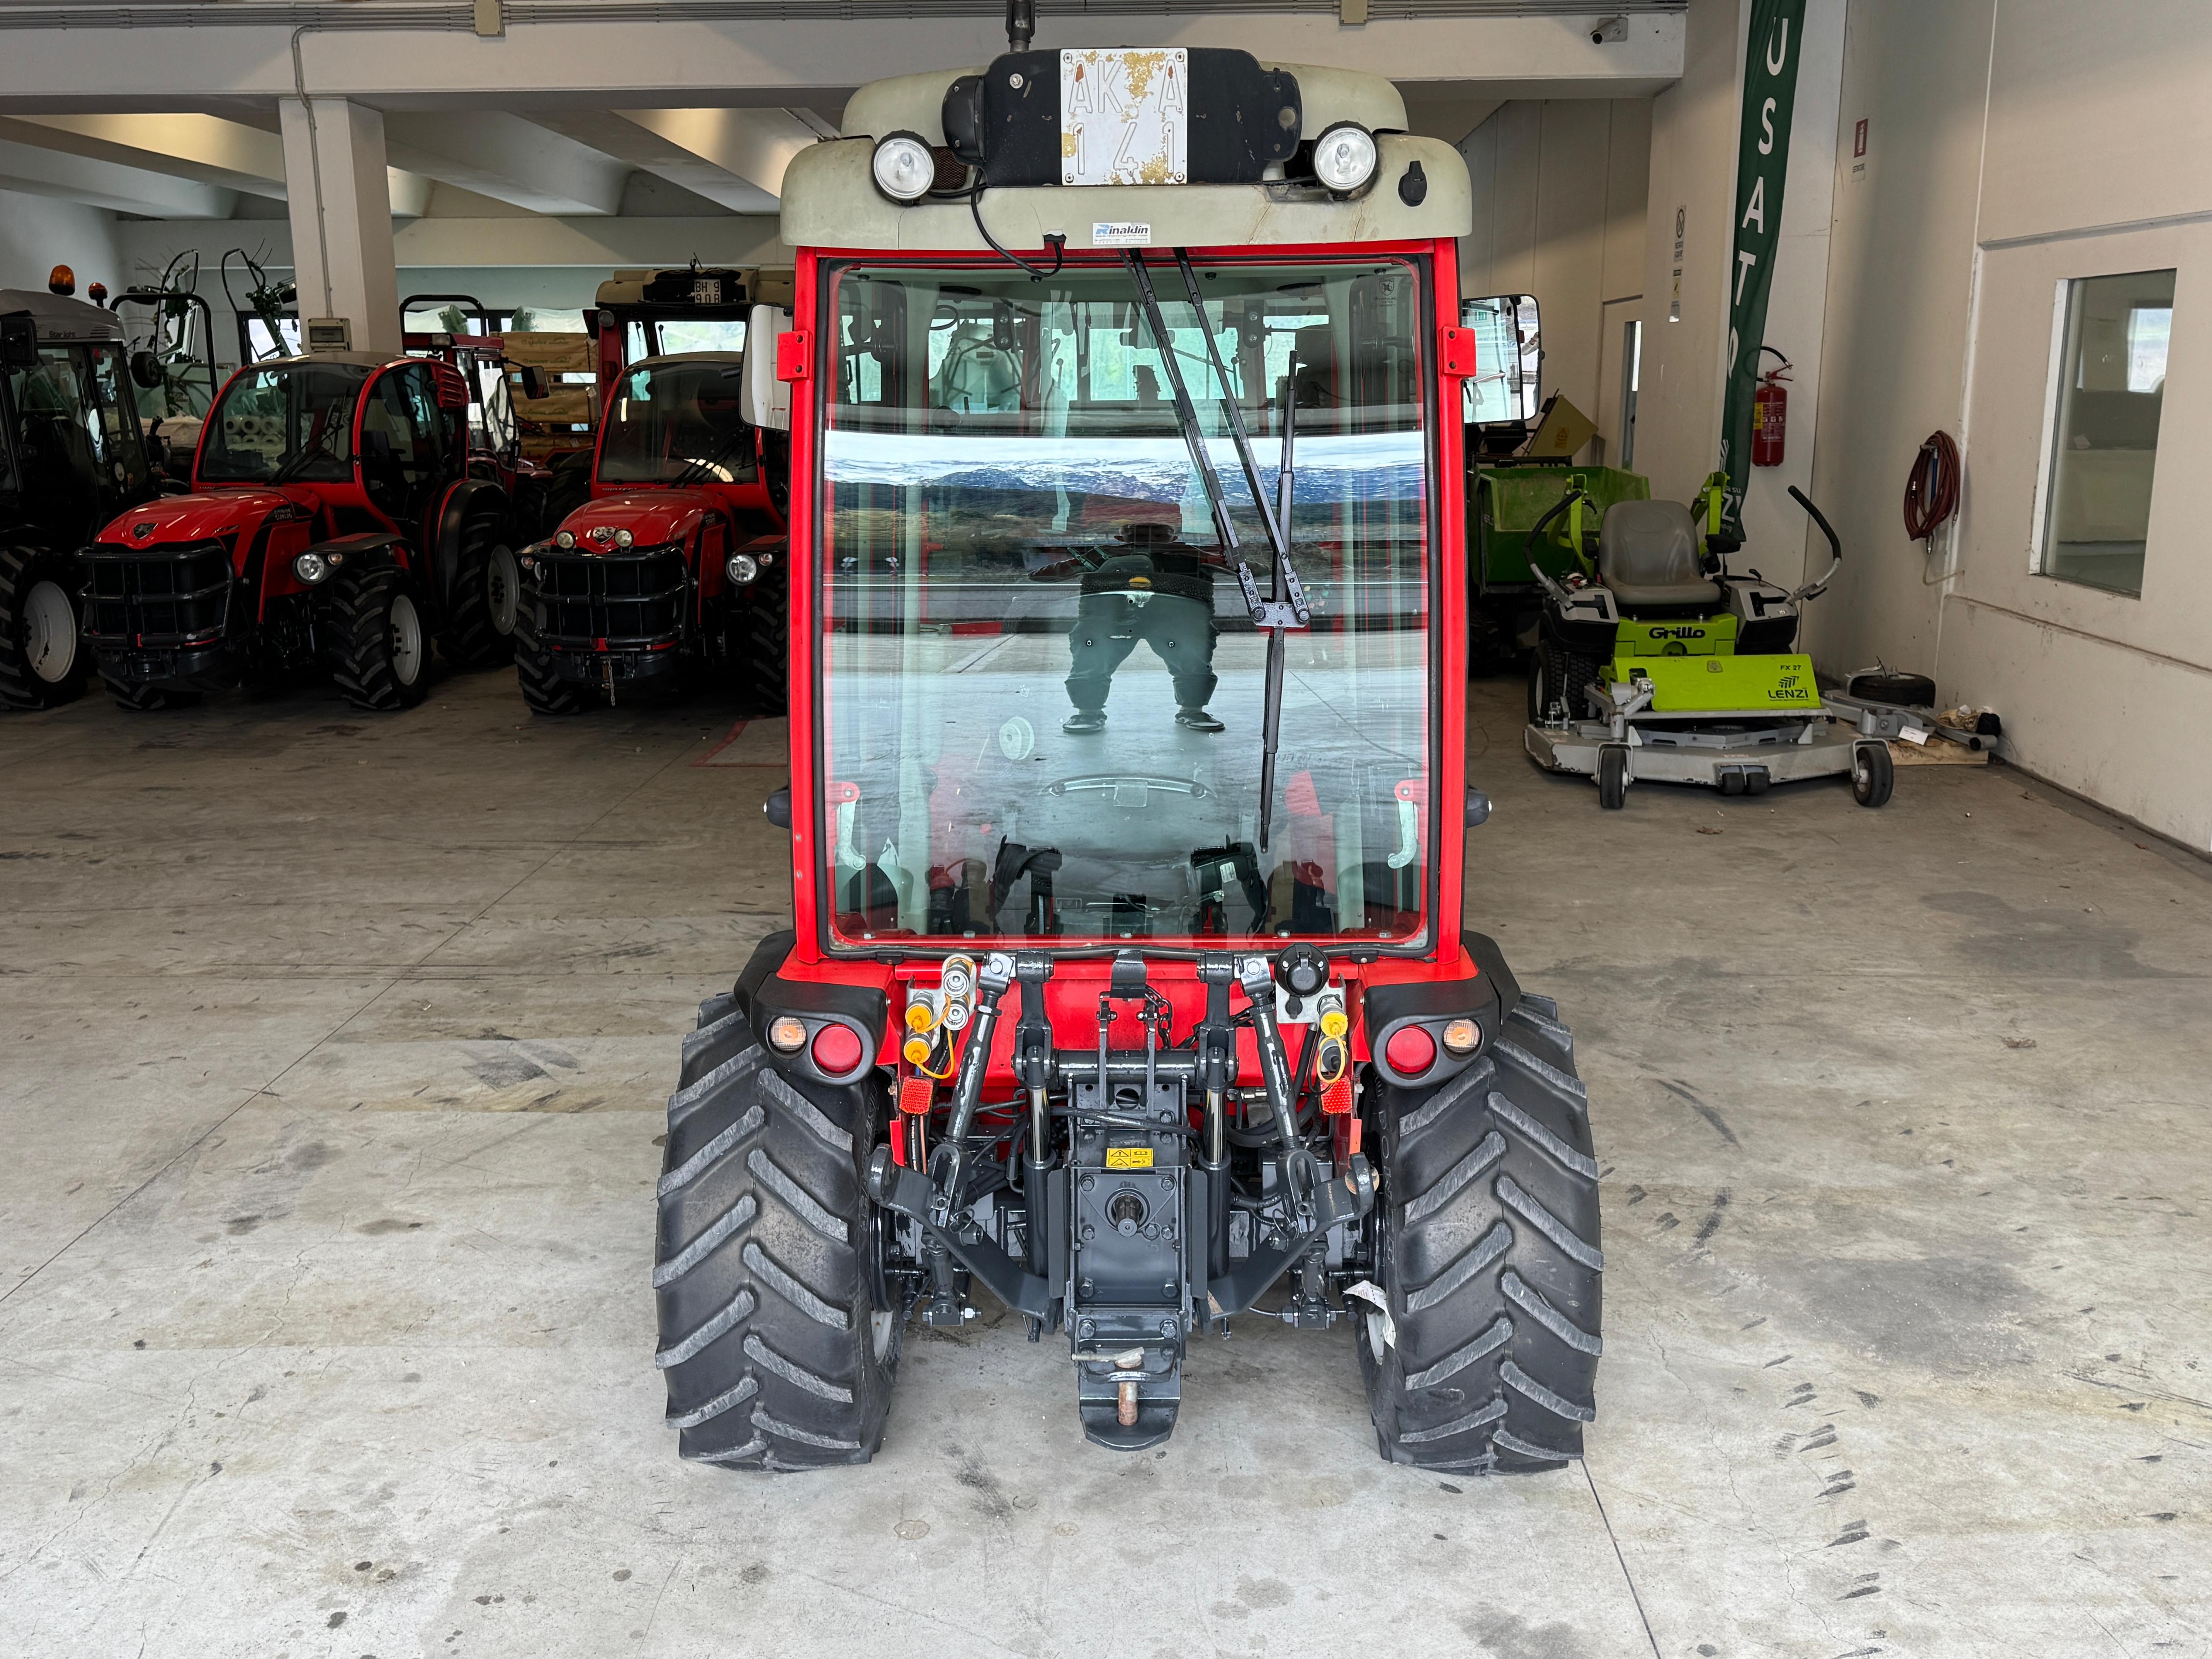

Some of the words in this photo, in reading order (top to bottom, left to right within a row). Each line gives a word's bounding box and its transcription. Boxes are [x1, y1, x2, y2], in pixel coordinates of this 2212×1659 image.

[1068, 60, 1123, 113] AK
[1158, 59, 1183, 113] A
[1096, 224, 1148, 235] Rinaldin
[696, 282, 707, 292] BH
[1649, 627, 1706, 639] Grillo
[1768, 689, 1808, 699] LENZI
